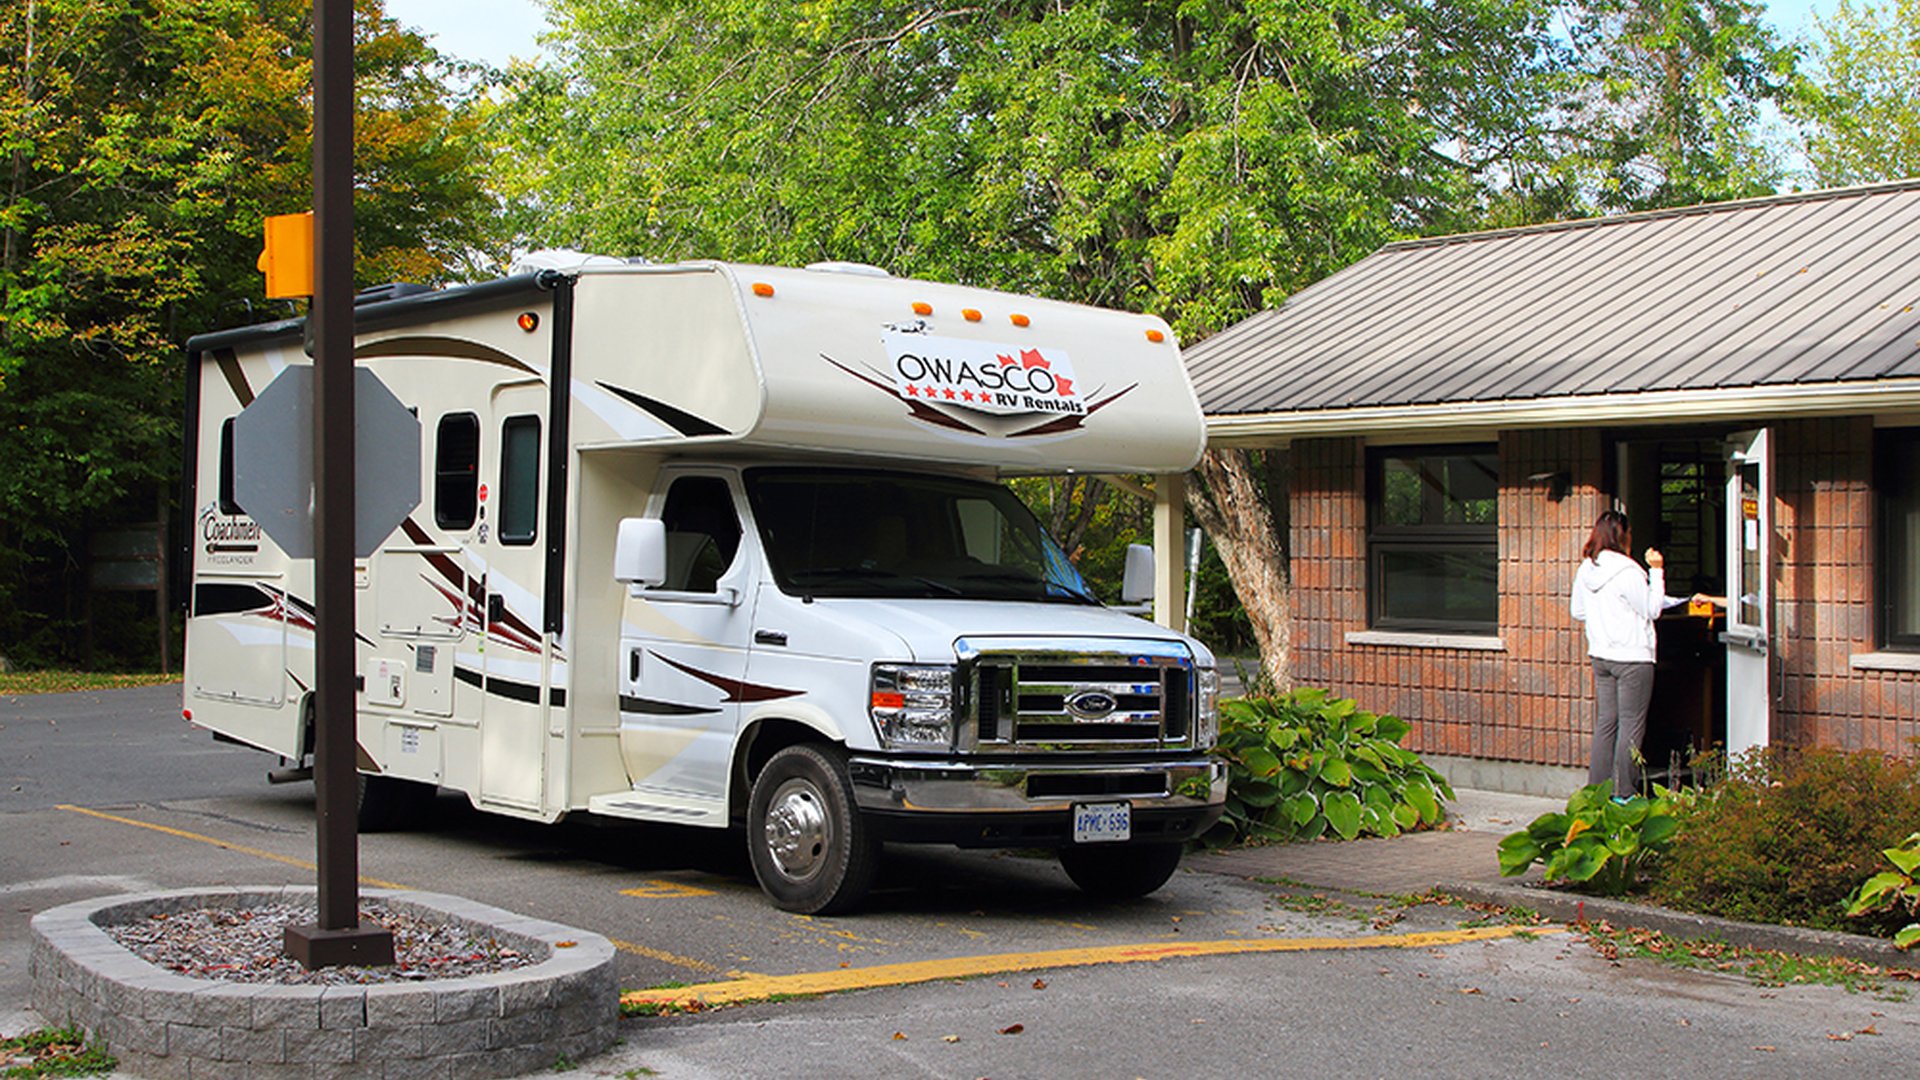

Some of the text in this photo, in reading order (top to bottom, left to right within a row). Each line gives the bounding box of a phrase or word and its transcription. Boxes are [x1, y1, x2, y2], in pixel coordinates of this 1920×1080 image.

[896, 353, 1056, 394] OWASCO
[995, 392, 1083, 413] RV Rentals
